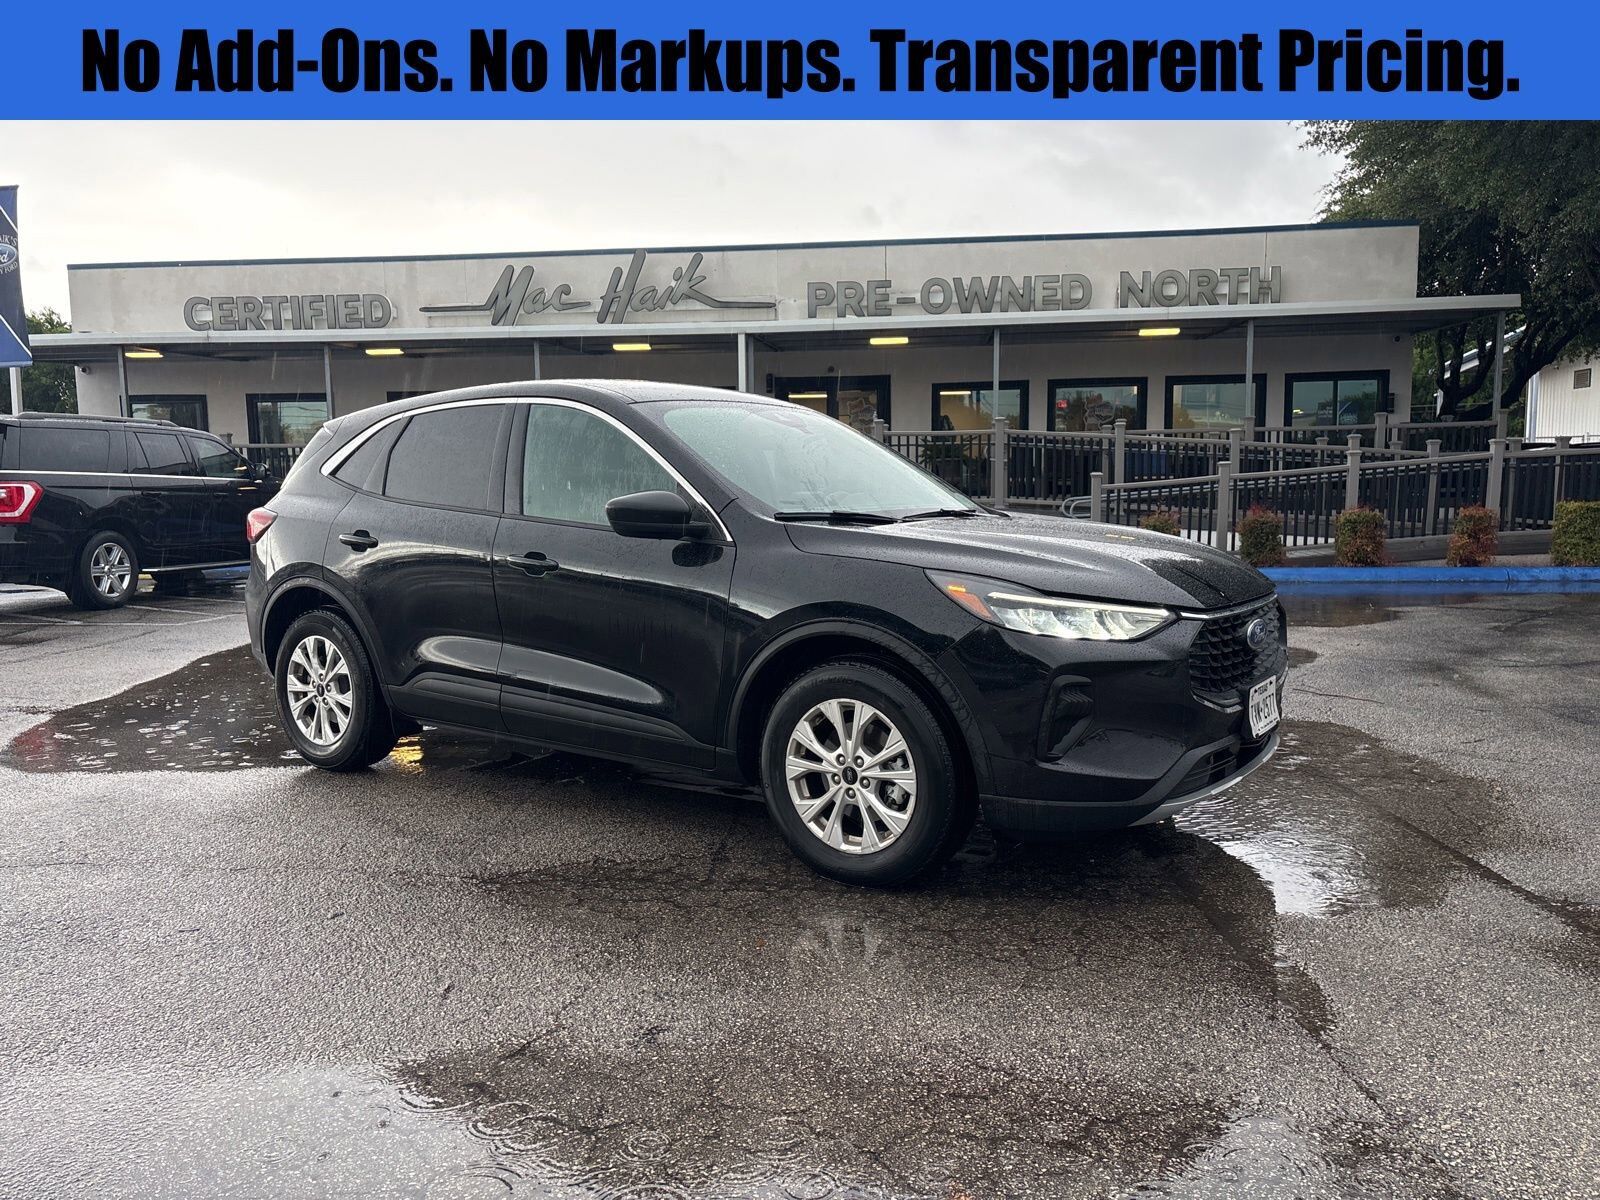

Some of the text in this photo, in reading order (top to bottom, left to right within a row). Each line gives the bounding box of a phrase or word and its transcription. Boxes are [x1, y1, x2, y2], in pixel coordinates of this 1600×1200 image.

[183, 292, 393, 332] CERTIFIED
[419, 249, 777, 327] Mac Haik
[806, 265, 1283, 319] PRE-OWNED NORTH
